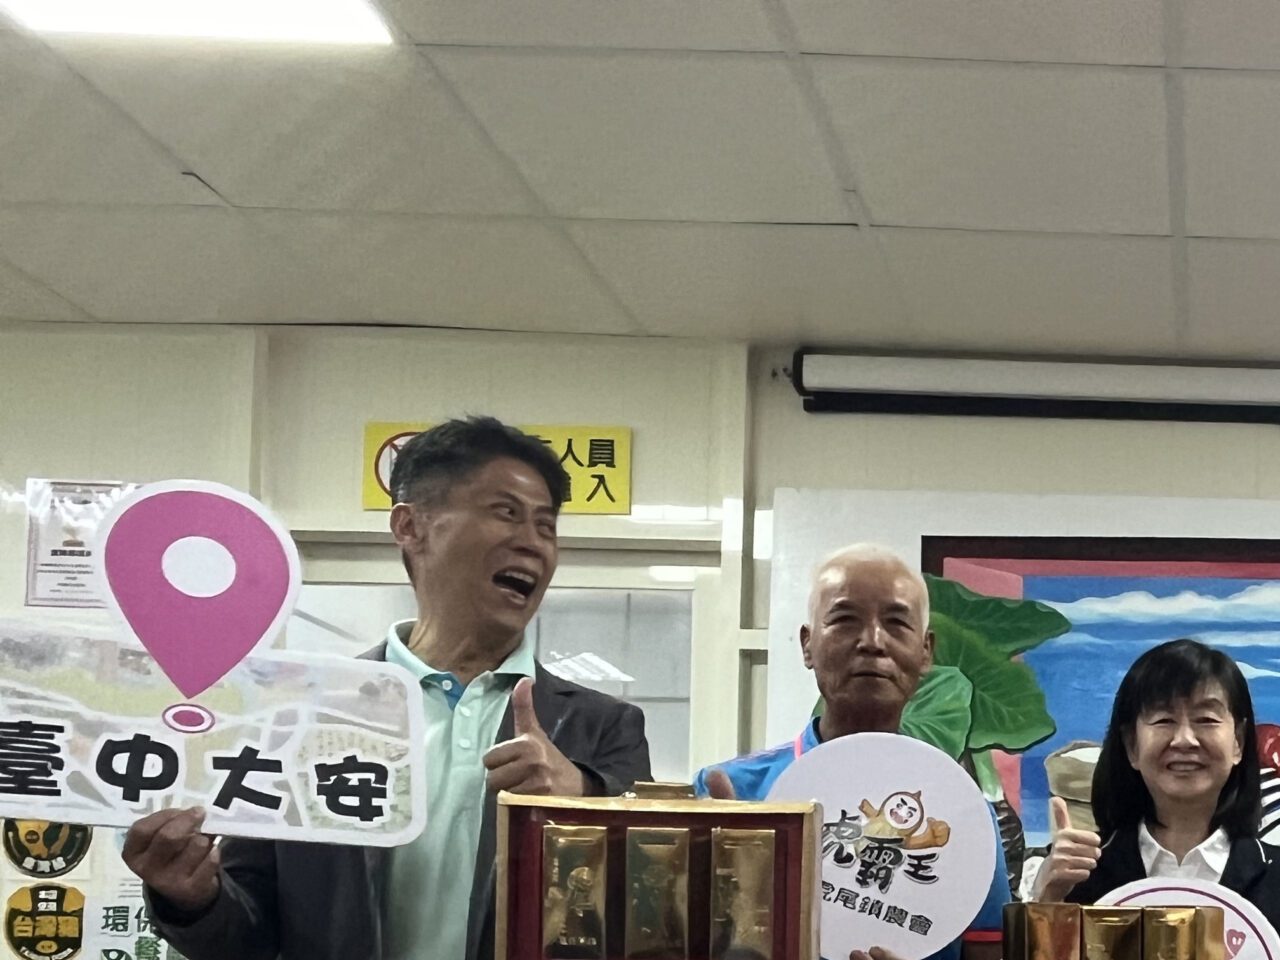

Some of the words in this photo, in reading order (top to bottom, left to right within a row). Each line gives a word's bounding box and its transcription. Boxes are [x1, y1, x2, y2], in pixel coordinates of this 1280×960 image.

[541, 435, 616, 468] 人員
[0, 720, 389, 822] 臺中大安
